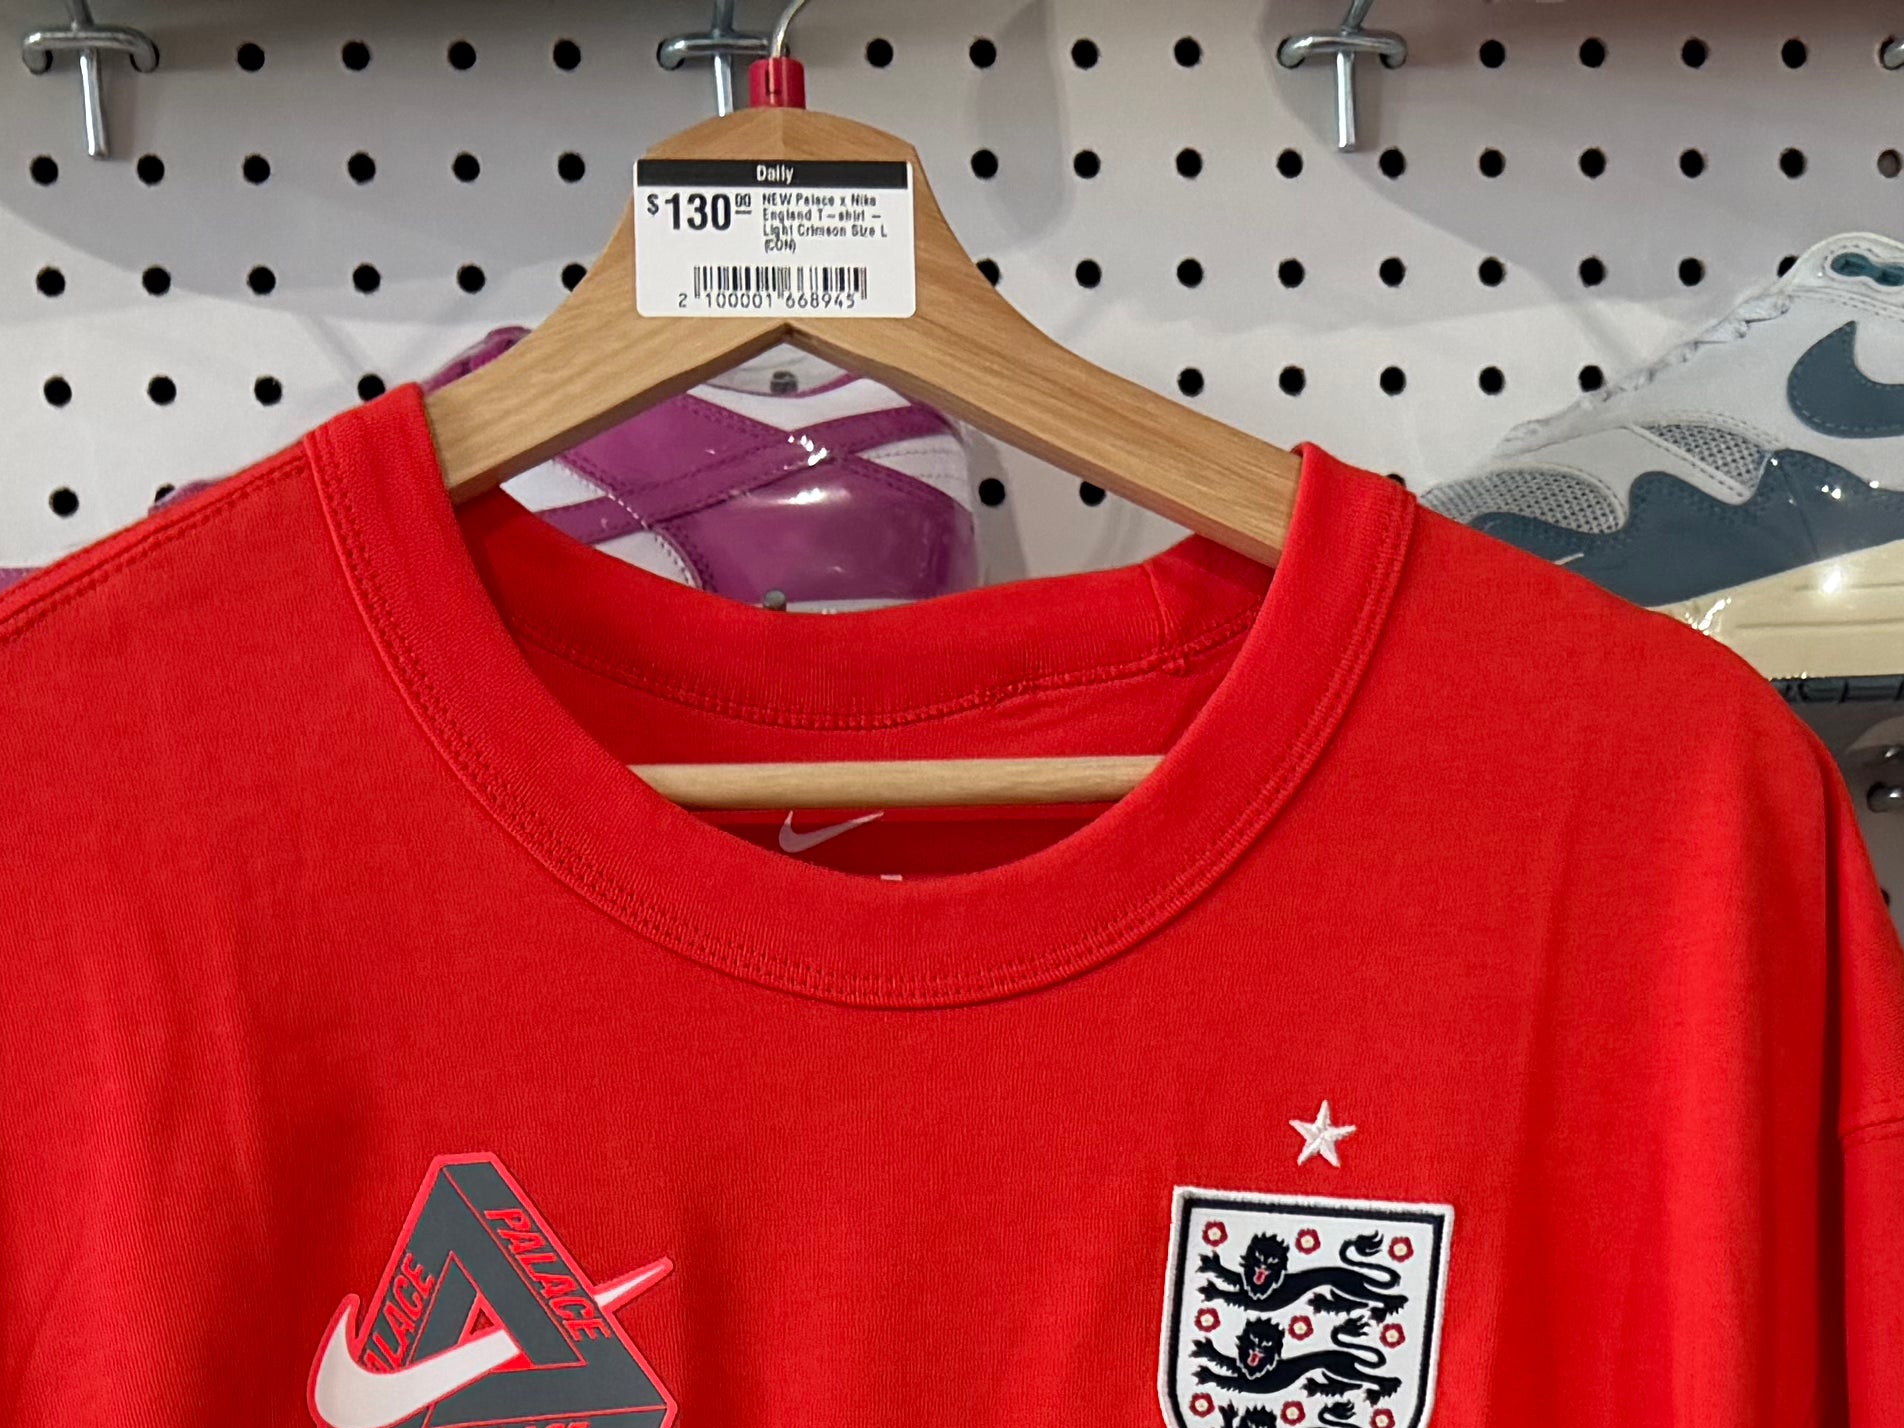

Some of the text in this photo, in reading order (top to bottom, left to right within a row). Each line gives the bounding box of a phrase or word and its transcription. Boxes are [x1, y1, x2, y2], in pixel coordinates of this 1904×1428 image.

[756, 164, 794, 185] Daily
[762, 192, 877, 207] NEW Palace x Nike
[762, 208, 812, 225] England
[762, 223, 888, 241] Light Crimson Size L
[678, 292, 856, 309] 2 100001 668945
[484, 1208, 611, 1342] PALACE
[362, 1251, 435, 1374] ALACE
